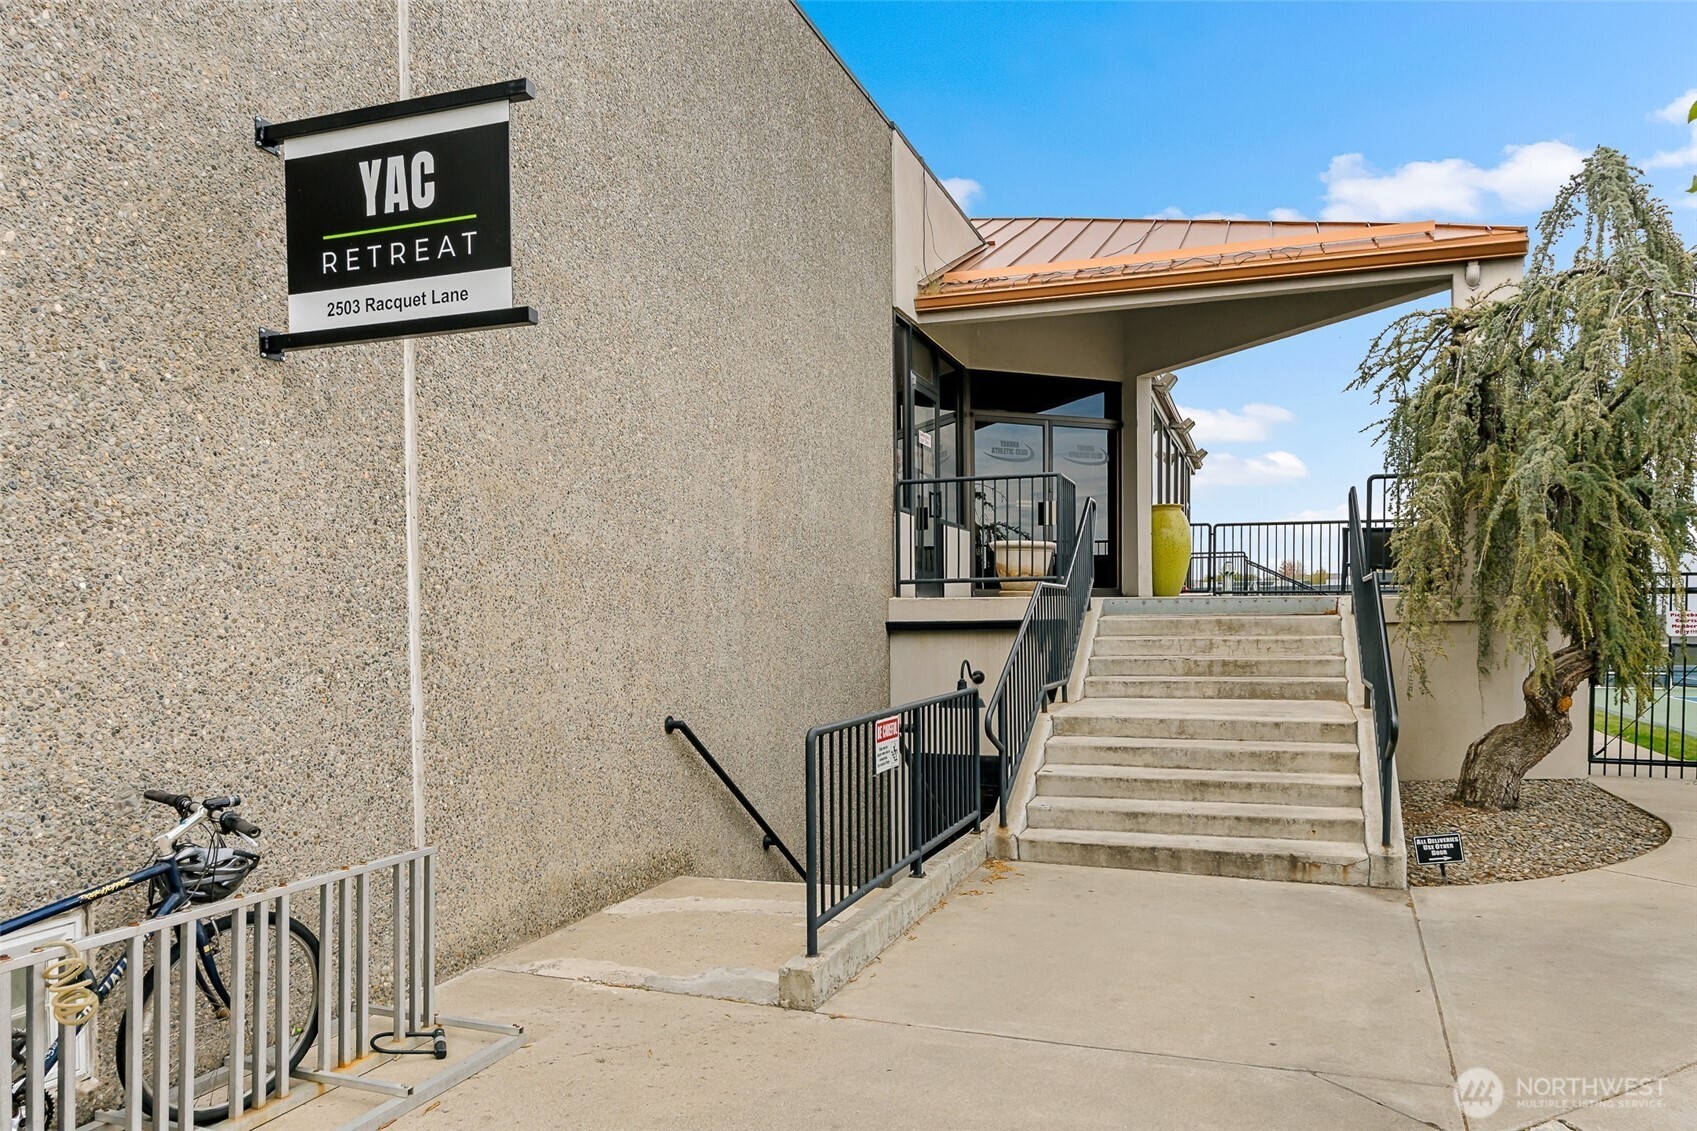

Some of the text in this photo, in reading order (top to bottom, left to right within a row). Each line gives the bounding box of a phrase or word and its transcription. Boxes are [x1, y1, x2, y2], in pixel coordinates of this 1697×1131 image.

[358, 150, 436, 217] YAC
[322, 231, 478, 274] RETREAT
[327, 288, 469, 317] 2503 Racquet Lane
[991, 447, 1029, 456] ATHLETIC CLUB
[1000, 440, 1019, 448] YAKIMA
[877, 724, 883, 740] BE
